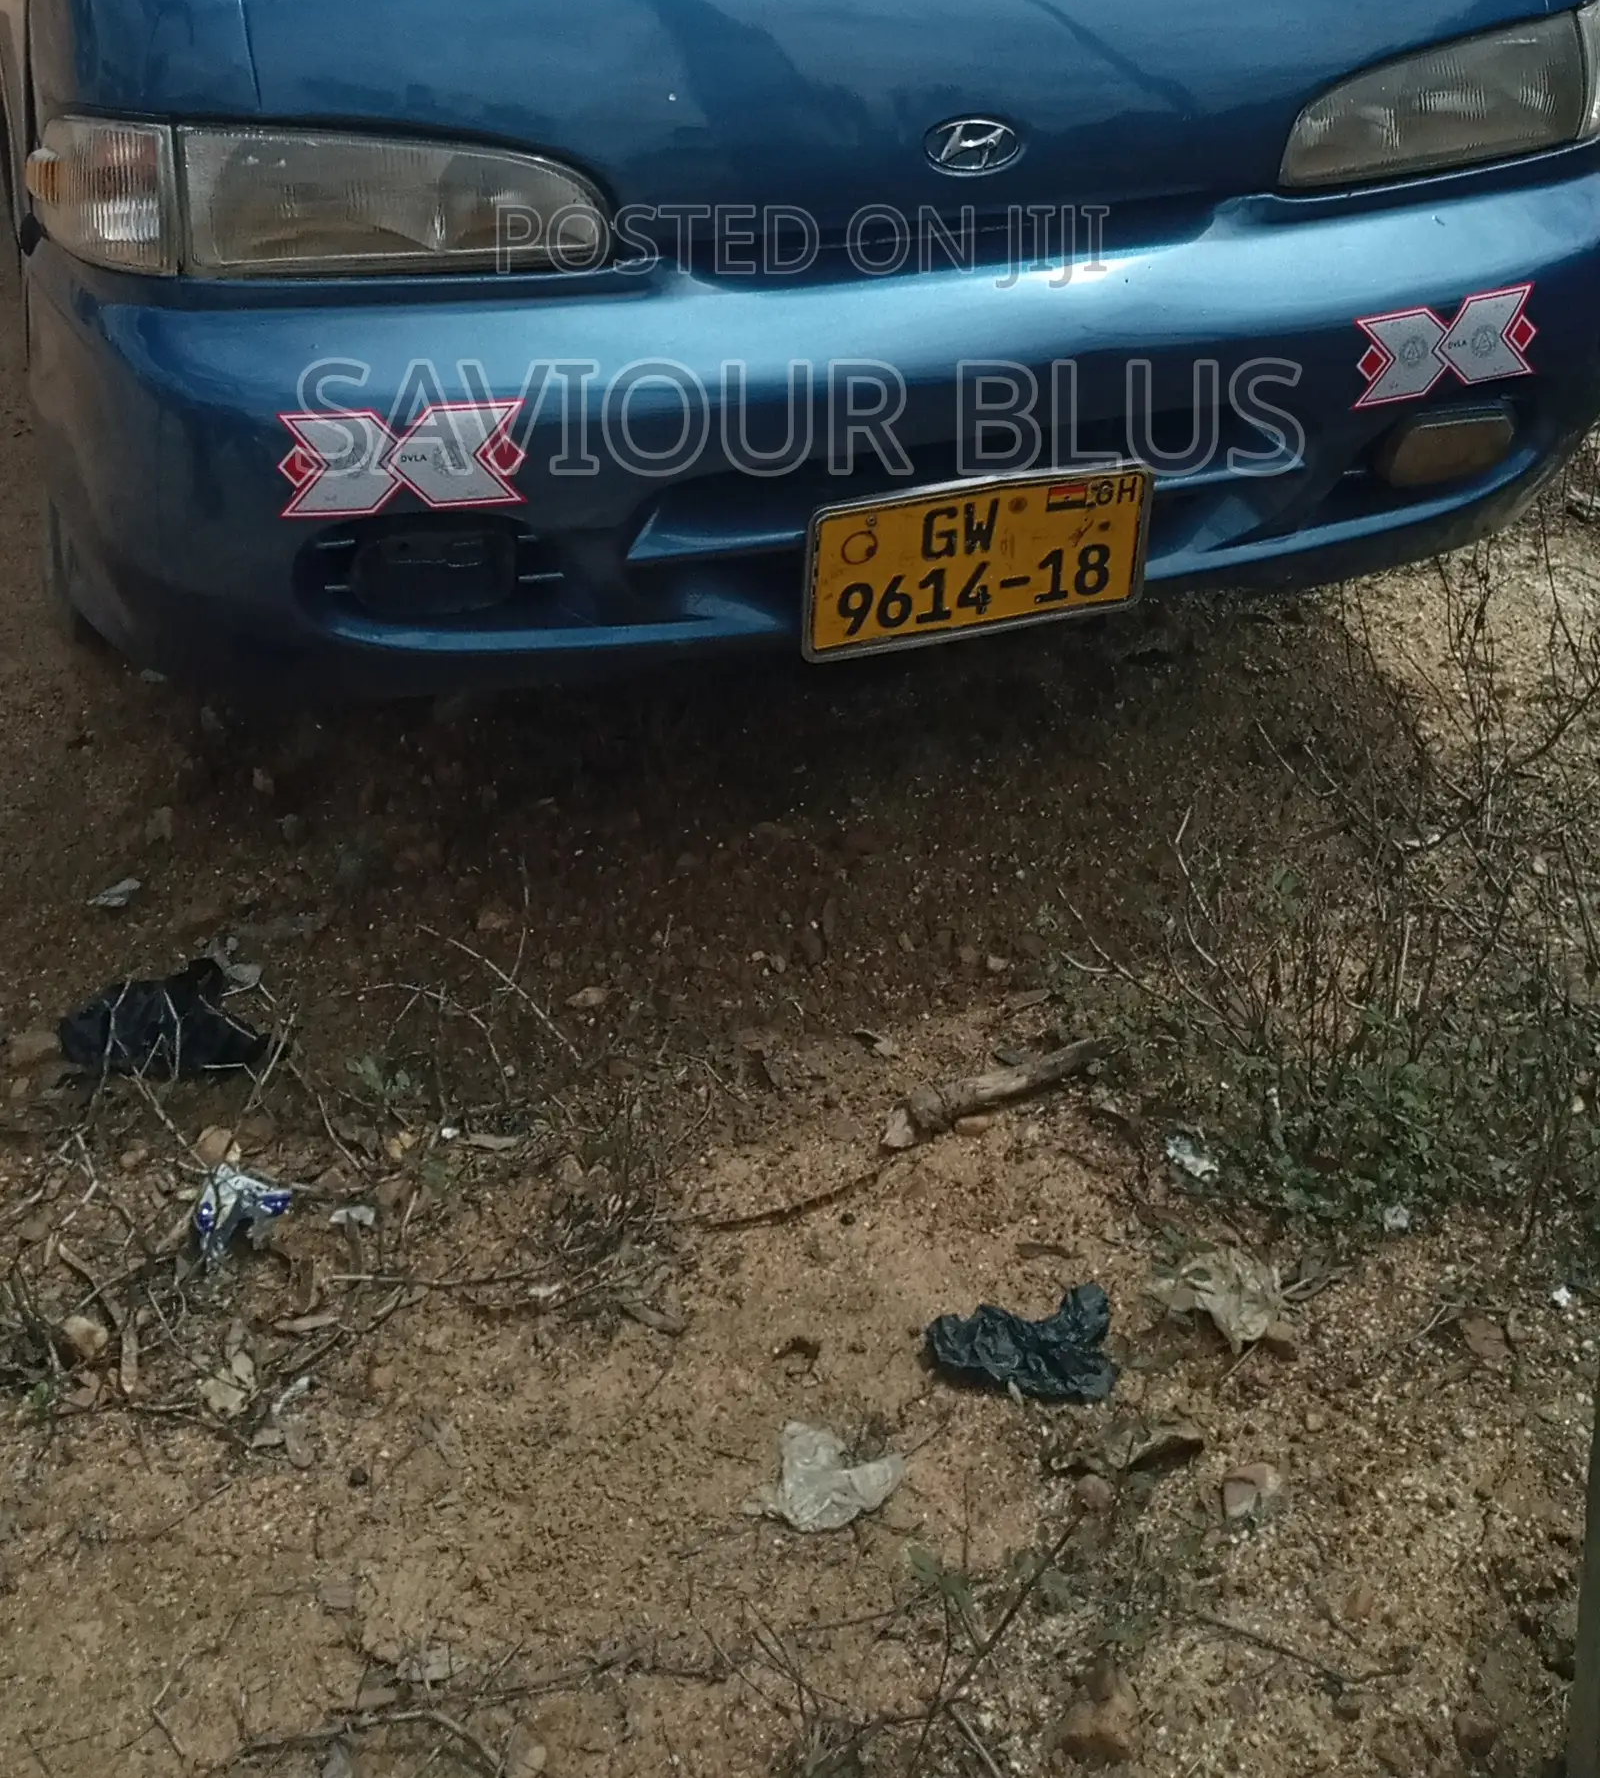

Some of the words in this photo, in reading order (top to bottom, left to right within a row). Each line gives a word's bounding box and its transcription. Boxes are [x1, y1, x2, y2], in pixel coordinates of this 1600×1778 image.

[401, 454, 427, 463] DVLA
[921, 498, 999, 562] GW
[838, 543, 1111, 637] 9614-18
